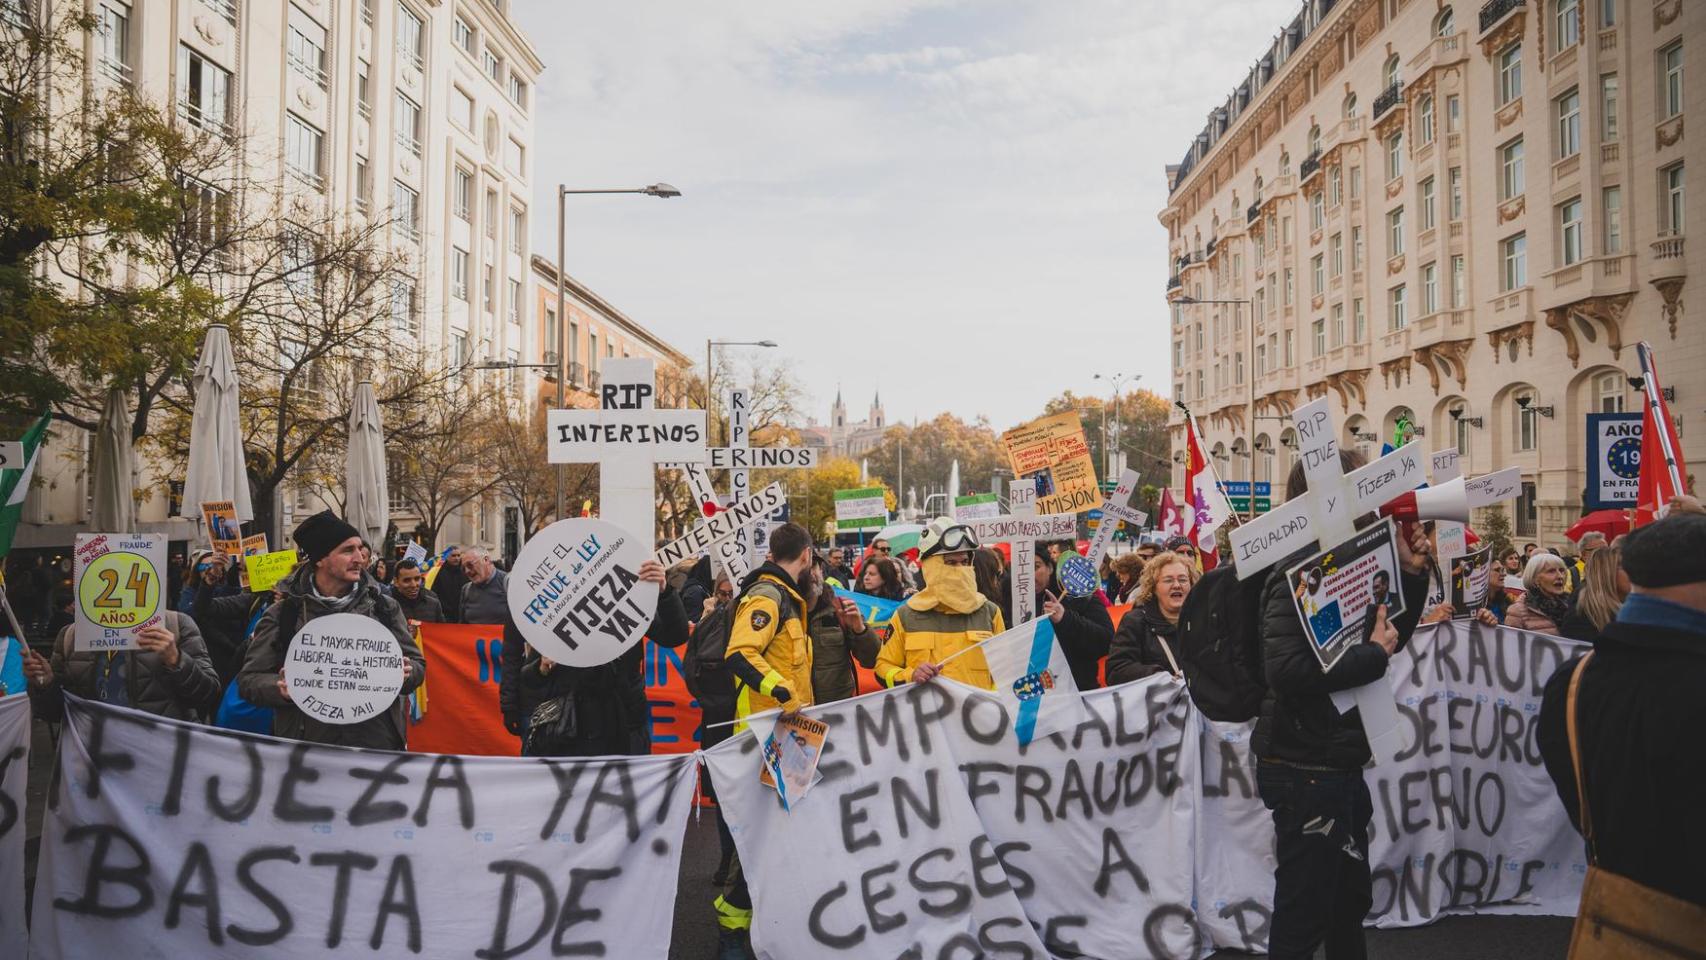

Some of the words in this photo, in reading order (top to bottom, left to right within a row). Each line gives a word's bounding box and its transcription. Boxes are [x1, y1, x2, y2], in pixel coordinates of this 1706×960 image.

[602, 383, 653, 410] RIP
[732, 391, 745, 443] RIP
[1297, 411, 1327, 442] RIP
[1605, 422, 1643, 437] AÑO
[557, 423, 700, 445] INTERINOS
[1433, 453, 1459, 470] RIP
[1619, 450, 1641, 466] 19
[1356, 469, 1396, 499] FIJEZA
[1400, 456, 1416, 477] YA
[1603, 480, 1616, 488] EN
[1619, 480, 1638, 488] FRA
[1011, 487, 1035, 505] RIP
[1613, 491, 1626, 499] DE
[657, 486, 778, 567] INTERINOS
[1240, 515, 1308, 562] IGUALDAD
[119, 541, 153, 549] FRAUDE
[576, 532, 603, 563] LEY
[256, 555, 273, 568] 25
[526, 556, 557, 591] ANTE
[552, 542, 574, 560] EL
[571, 562, 585, 576] de
[1323, 568, 1355, 588] CUMPLAN
[1355, 560, 1368, 571] CON
[93, 562, 151, 608] 24
[522, 569, 571, 624] FRAUDE
[1339, 580, 1369, 600] EUROPEA
[541, 611, 556, 627] POR
[554, 594, 573, 615] ABUSO
[571, 584, 582, 594] DE
[552, 563, 640, 651] FIJEZA
[1343, 591, 1369, 608] CONTRA
[99, 609, 137, 624] AÑOS
[89, 638, 128, 649] FRAUDE
[104, 628, 120, 638] EN
[301, 633, 316, 647] EL
[320, 635, 354, 651] MAYOR
[355, 638, 393, 654] FRAUDE
[293, 649, 338, 665] LABORAL
[341, 657, 352, 667] de
[353, 658, 362, 667] la
[1405, 625, 1592, 698] FRAUD
[293, 677, 324, 689] DONDE
[327, 680, 357, 691] ESTAN
[313, 666, 324, 675] de
[330, 668, 369, 680] ESPAÑA
[302, 694, 345, 720] FIJEZA
[351, 701, 375, 718] YA!!
[740, 680, 1190, 780] EMPOALES
[1446, 697, 1546, 768] EURO
[839, 767, 942, 854] EN
[958, 752, 1184, 824] FRAUDE
[52, 823, 422, 953] BASTA
[474, 858, 623, 960] DE
[808, 834, 1036, 950] CESES
[1093, 826, 1150, 898] A
